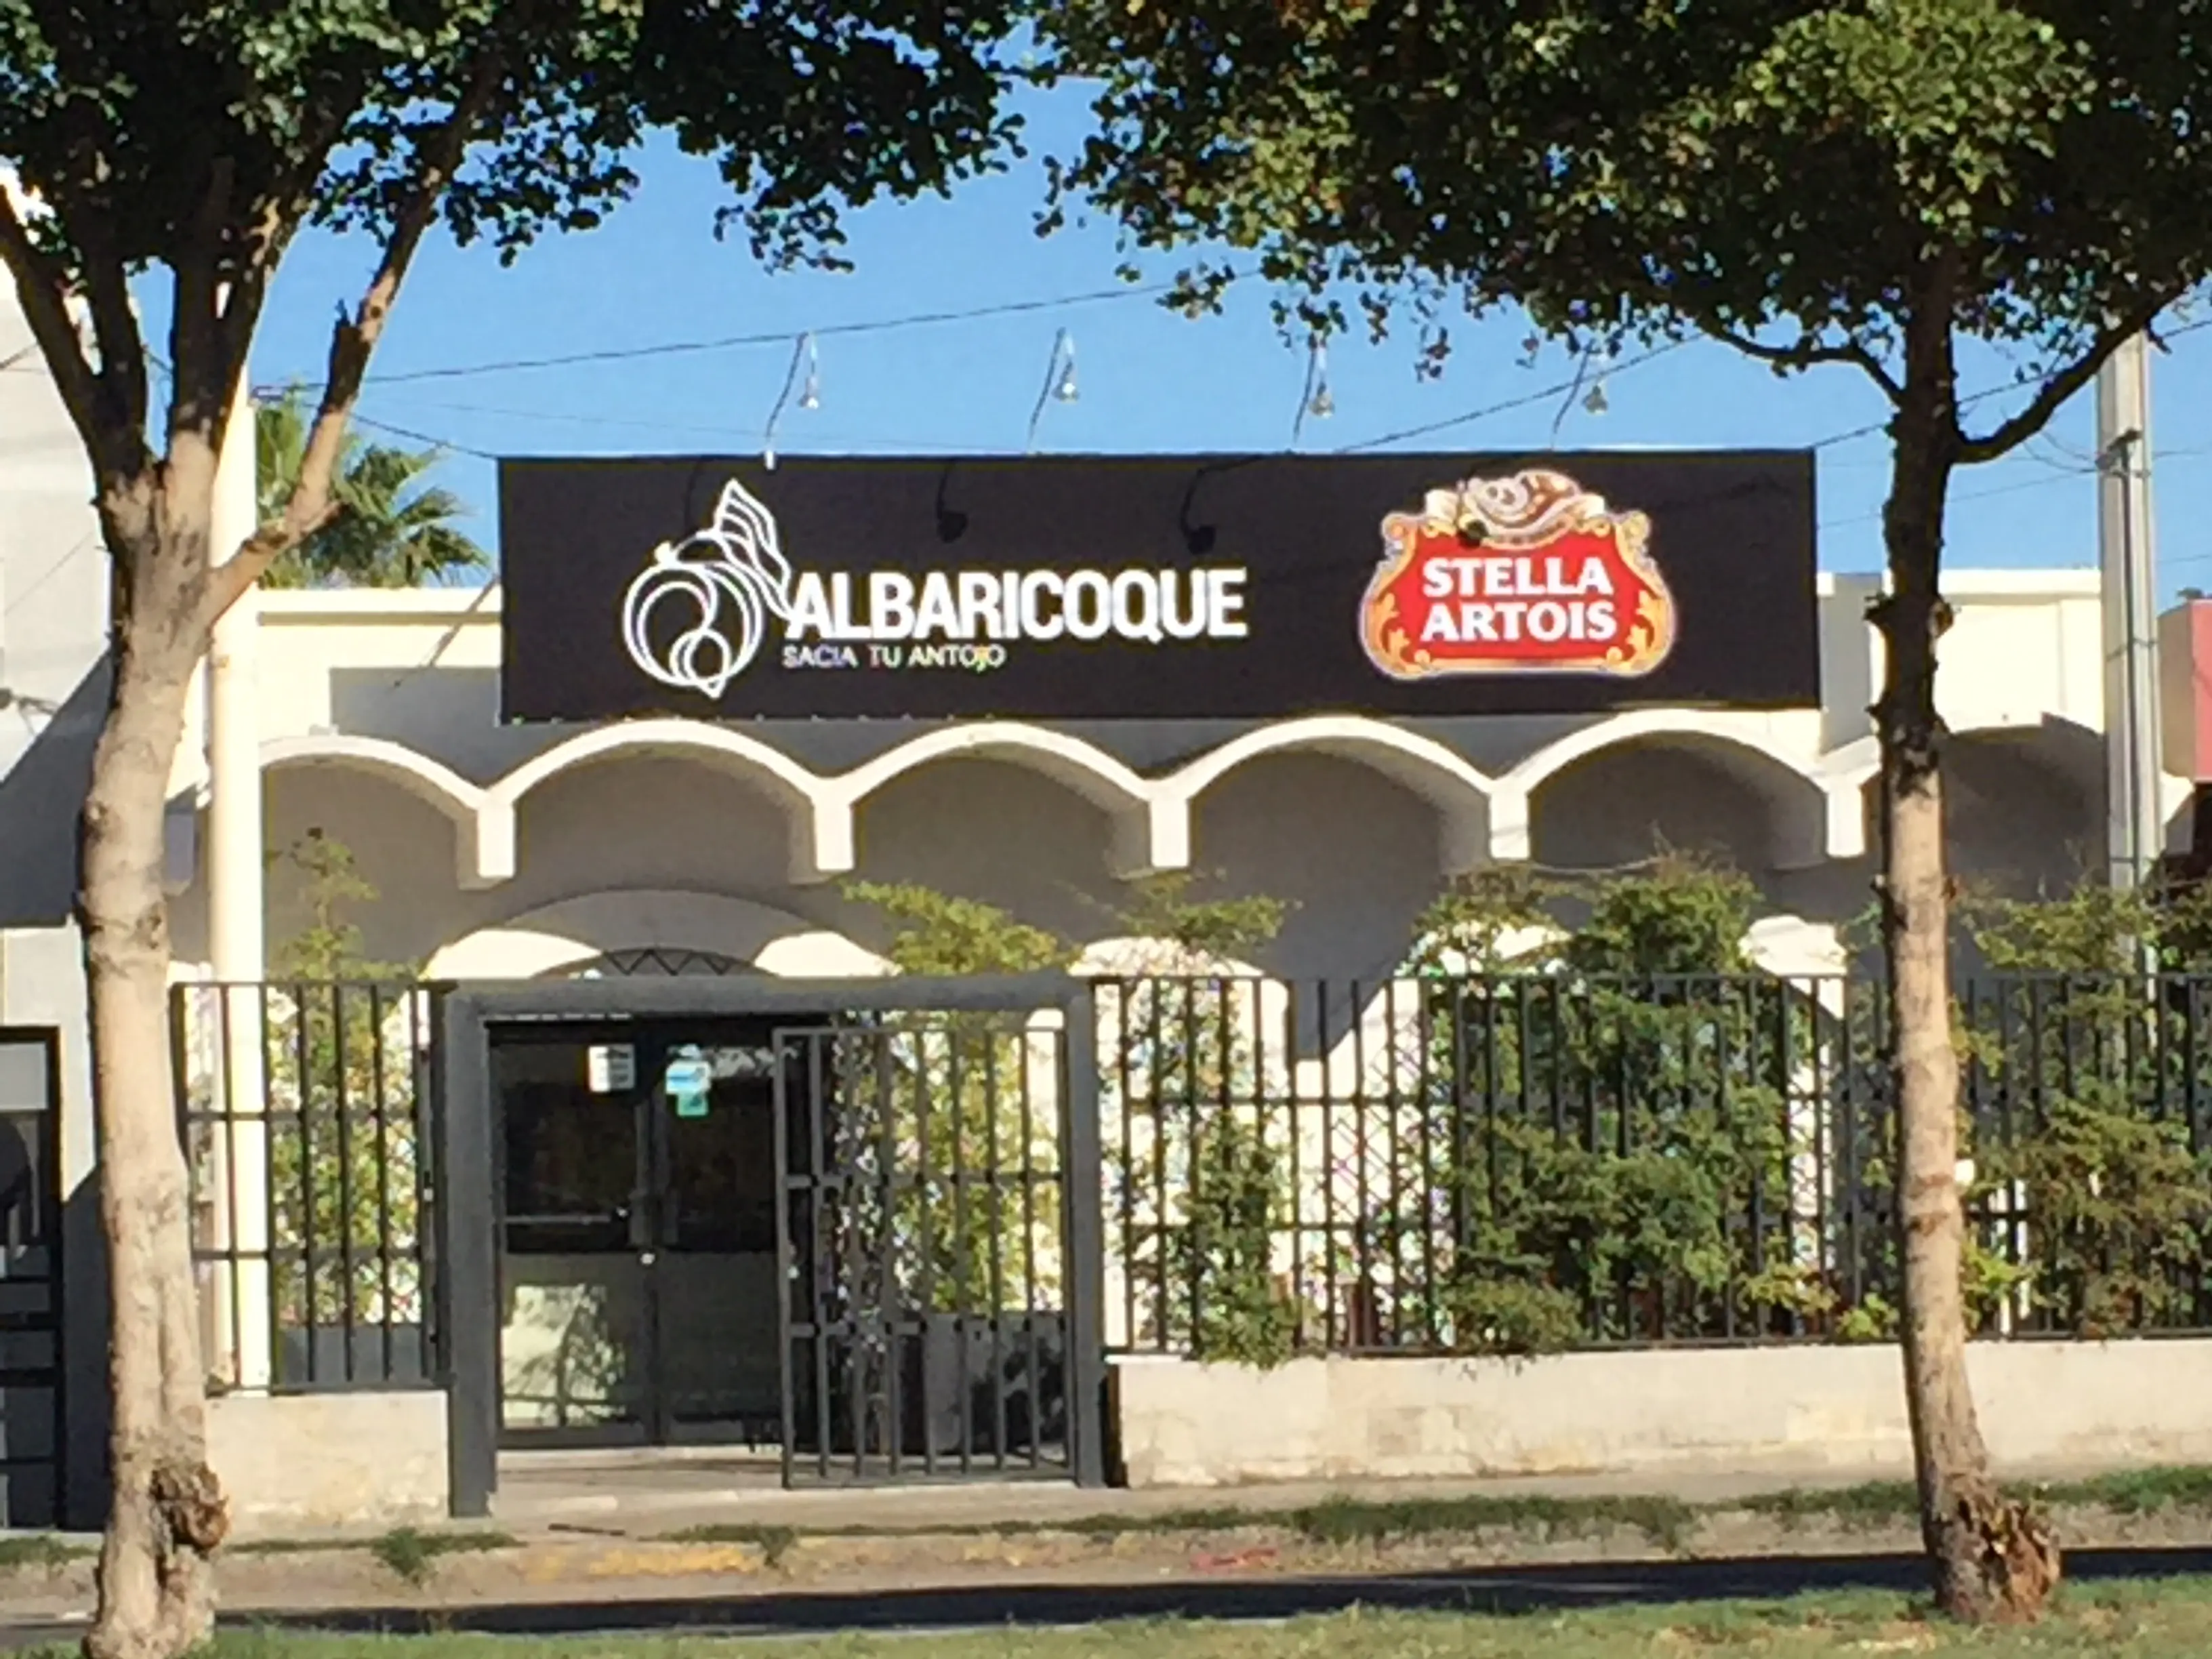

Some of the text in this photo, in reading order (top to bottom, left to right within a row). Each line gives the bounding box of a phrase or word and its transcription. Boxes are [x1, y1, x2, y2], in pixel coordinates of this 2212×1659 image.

[1422, 557, 1614, 597] STELLA
[784, 567, 1248, 643] ALBARICOQUE
[1420, 601, 1618, 642] ARTOIS
[782, 643, 1007, 674] SACIA TU ANTOJO
